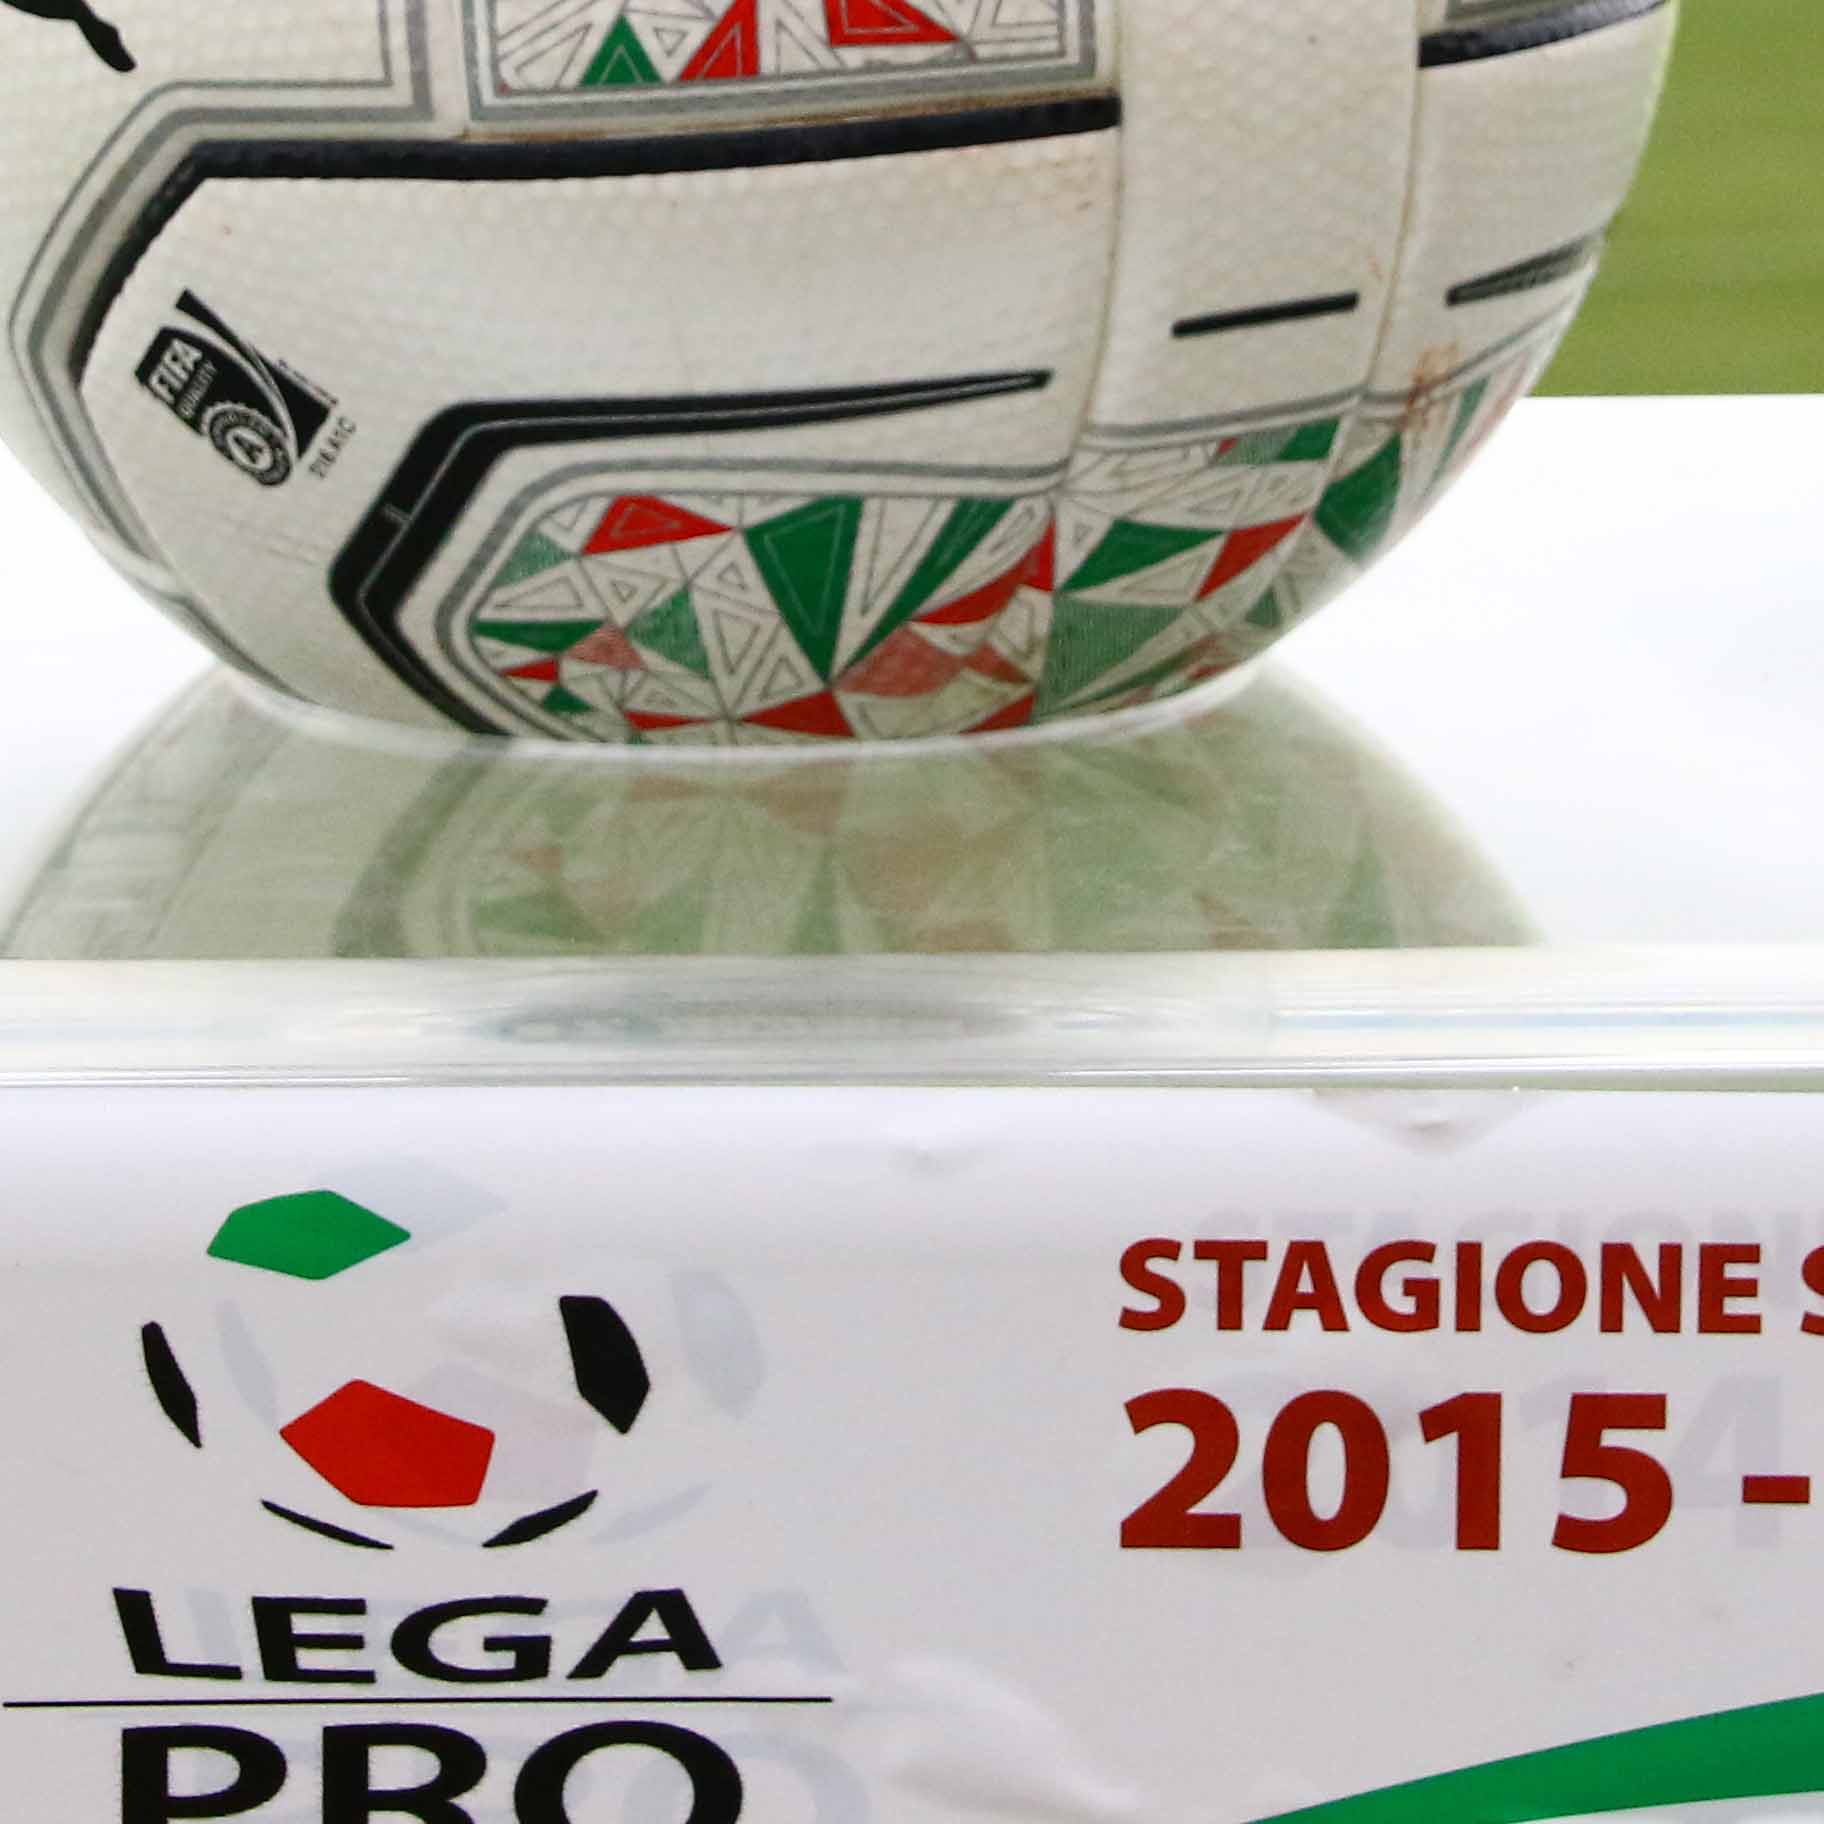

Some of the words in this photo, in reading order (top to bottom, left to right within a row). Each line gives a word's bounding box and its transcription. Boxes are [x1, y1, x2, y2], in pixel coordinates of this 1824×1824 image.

[148, 338, 203, 406] FIFA
[1119, 1237, 1761, 1335] STAGIONE
[1119, 1387, 1673, 1554] 2015
[1742, 1474, 1810, 1504] -
[112, 1587, 723, 1685] LEGA
[121, 1720, 743, 1824] PRO
